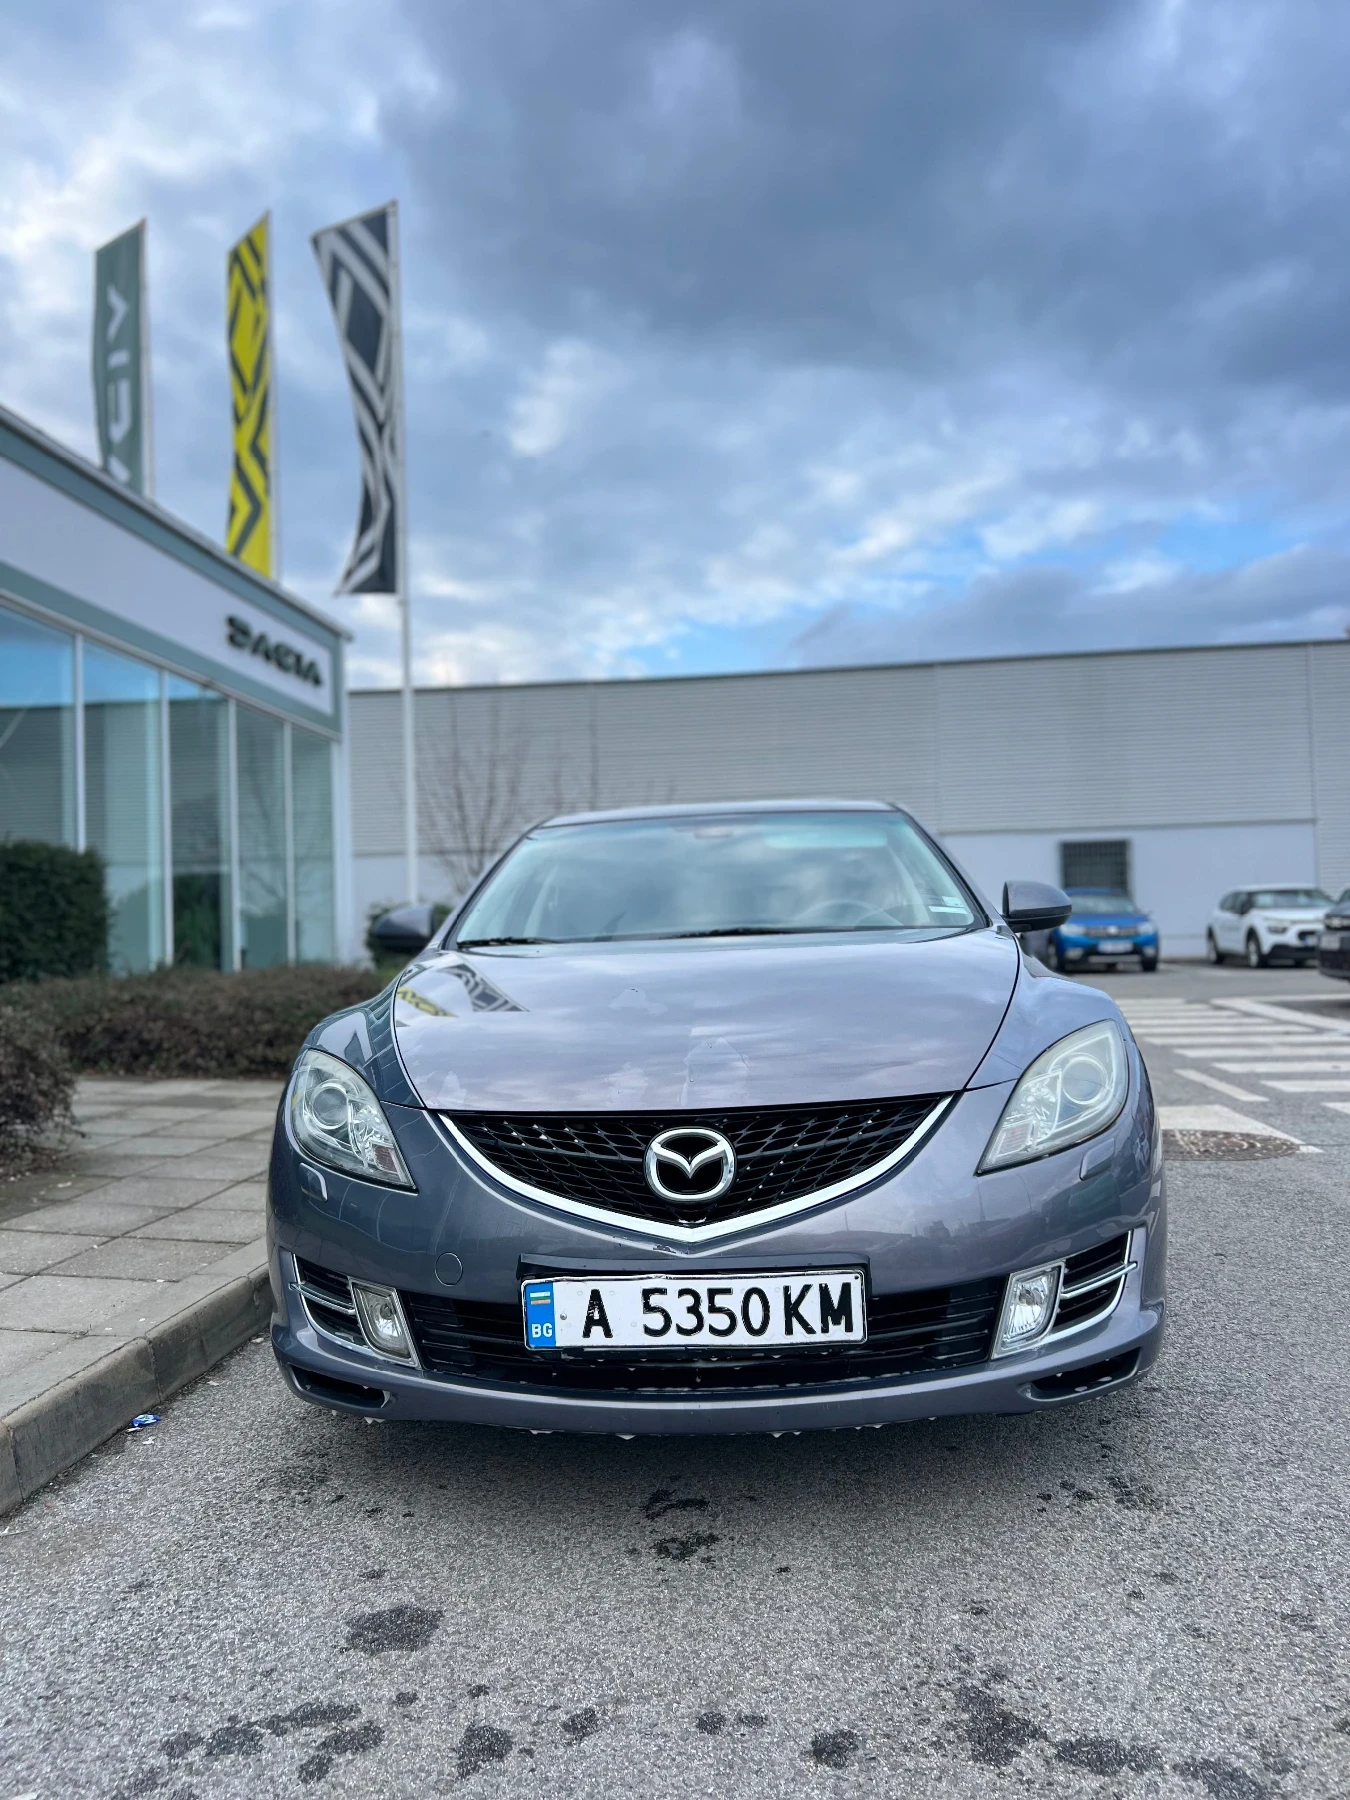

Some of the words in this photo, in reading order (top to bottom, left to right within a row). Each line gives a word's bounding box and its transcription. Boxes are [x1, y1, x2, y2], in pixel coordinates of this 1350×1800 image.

[226, 616, 322, 687] DACIA
[531, 1322, 553, 1338] BG
[582, 1288, 613, 1339] A
[641, 1287, 770, 1338] 5350
[783, 1282, 854, 1335] KM
